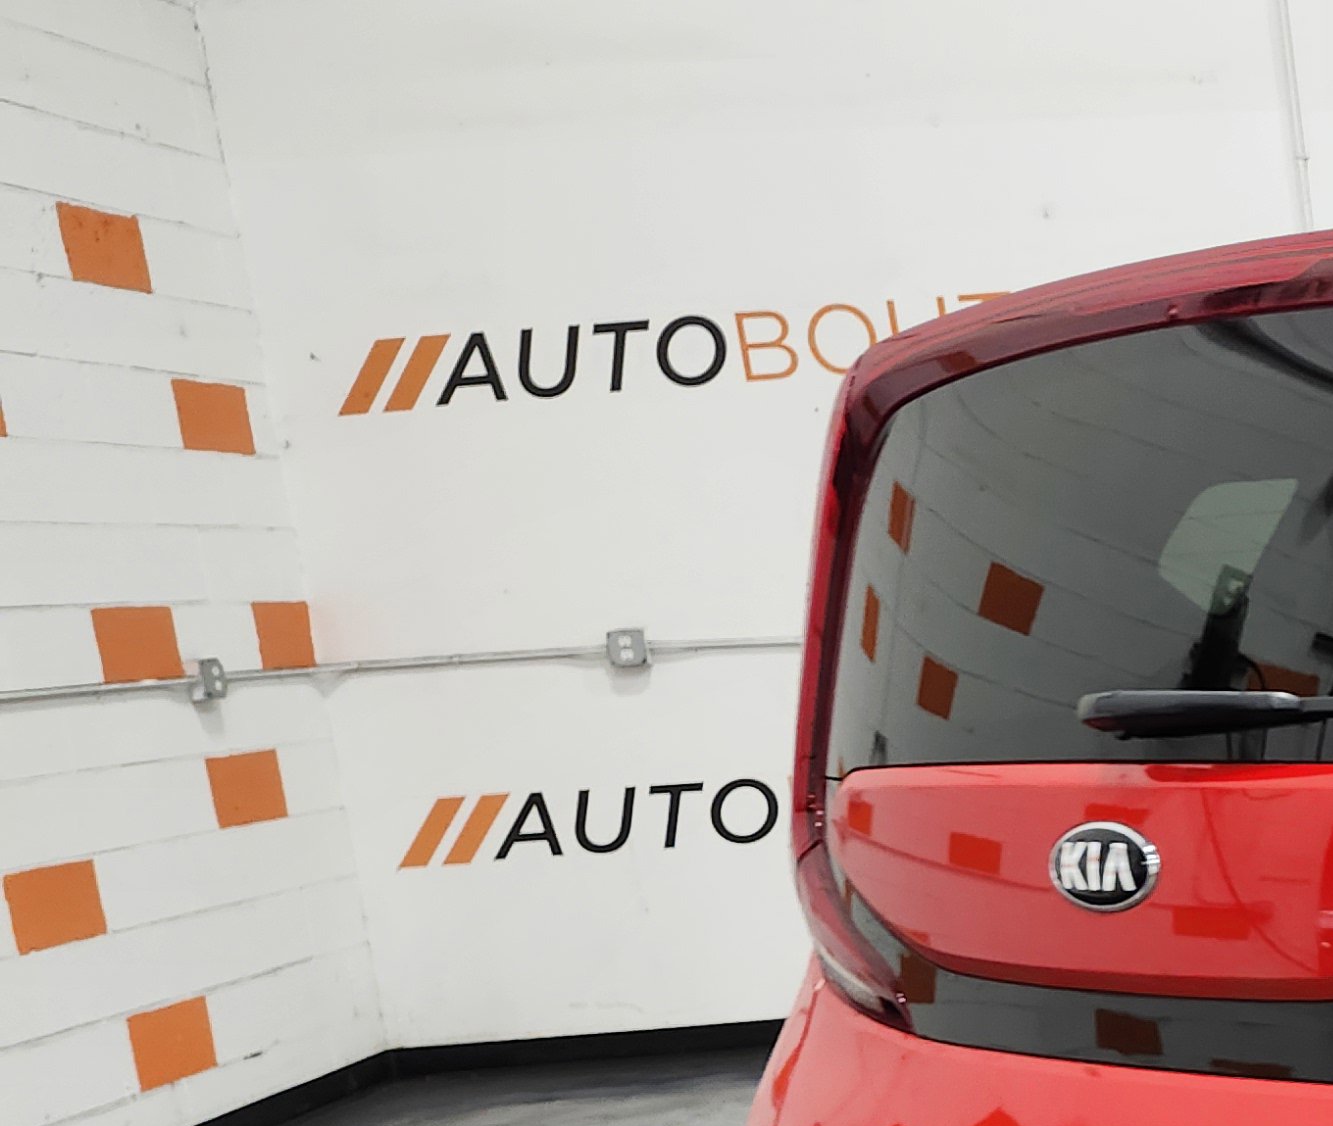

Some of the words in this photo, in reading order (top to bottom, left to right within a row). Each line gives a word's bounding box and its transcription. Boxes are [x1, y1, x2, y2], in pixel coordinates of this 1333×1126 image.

[436, 291, 1012, 406] AUTOBO
[494, 778, 797, 861] AUTO
[1059, 841, 1138, 892] KIA
